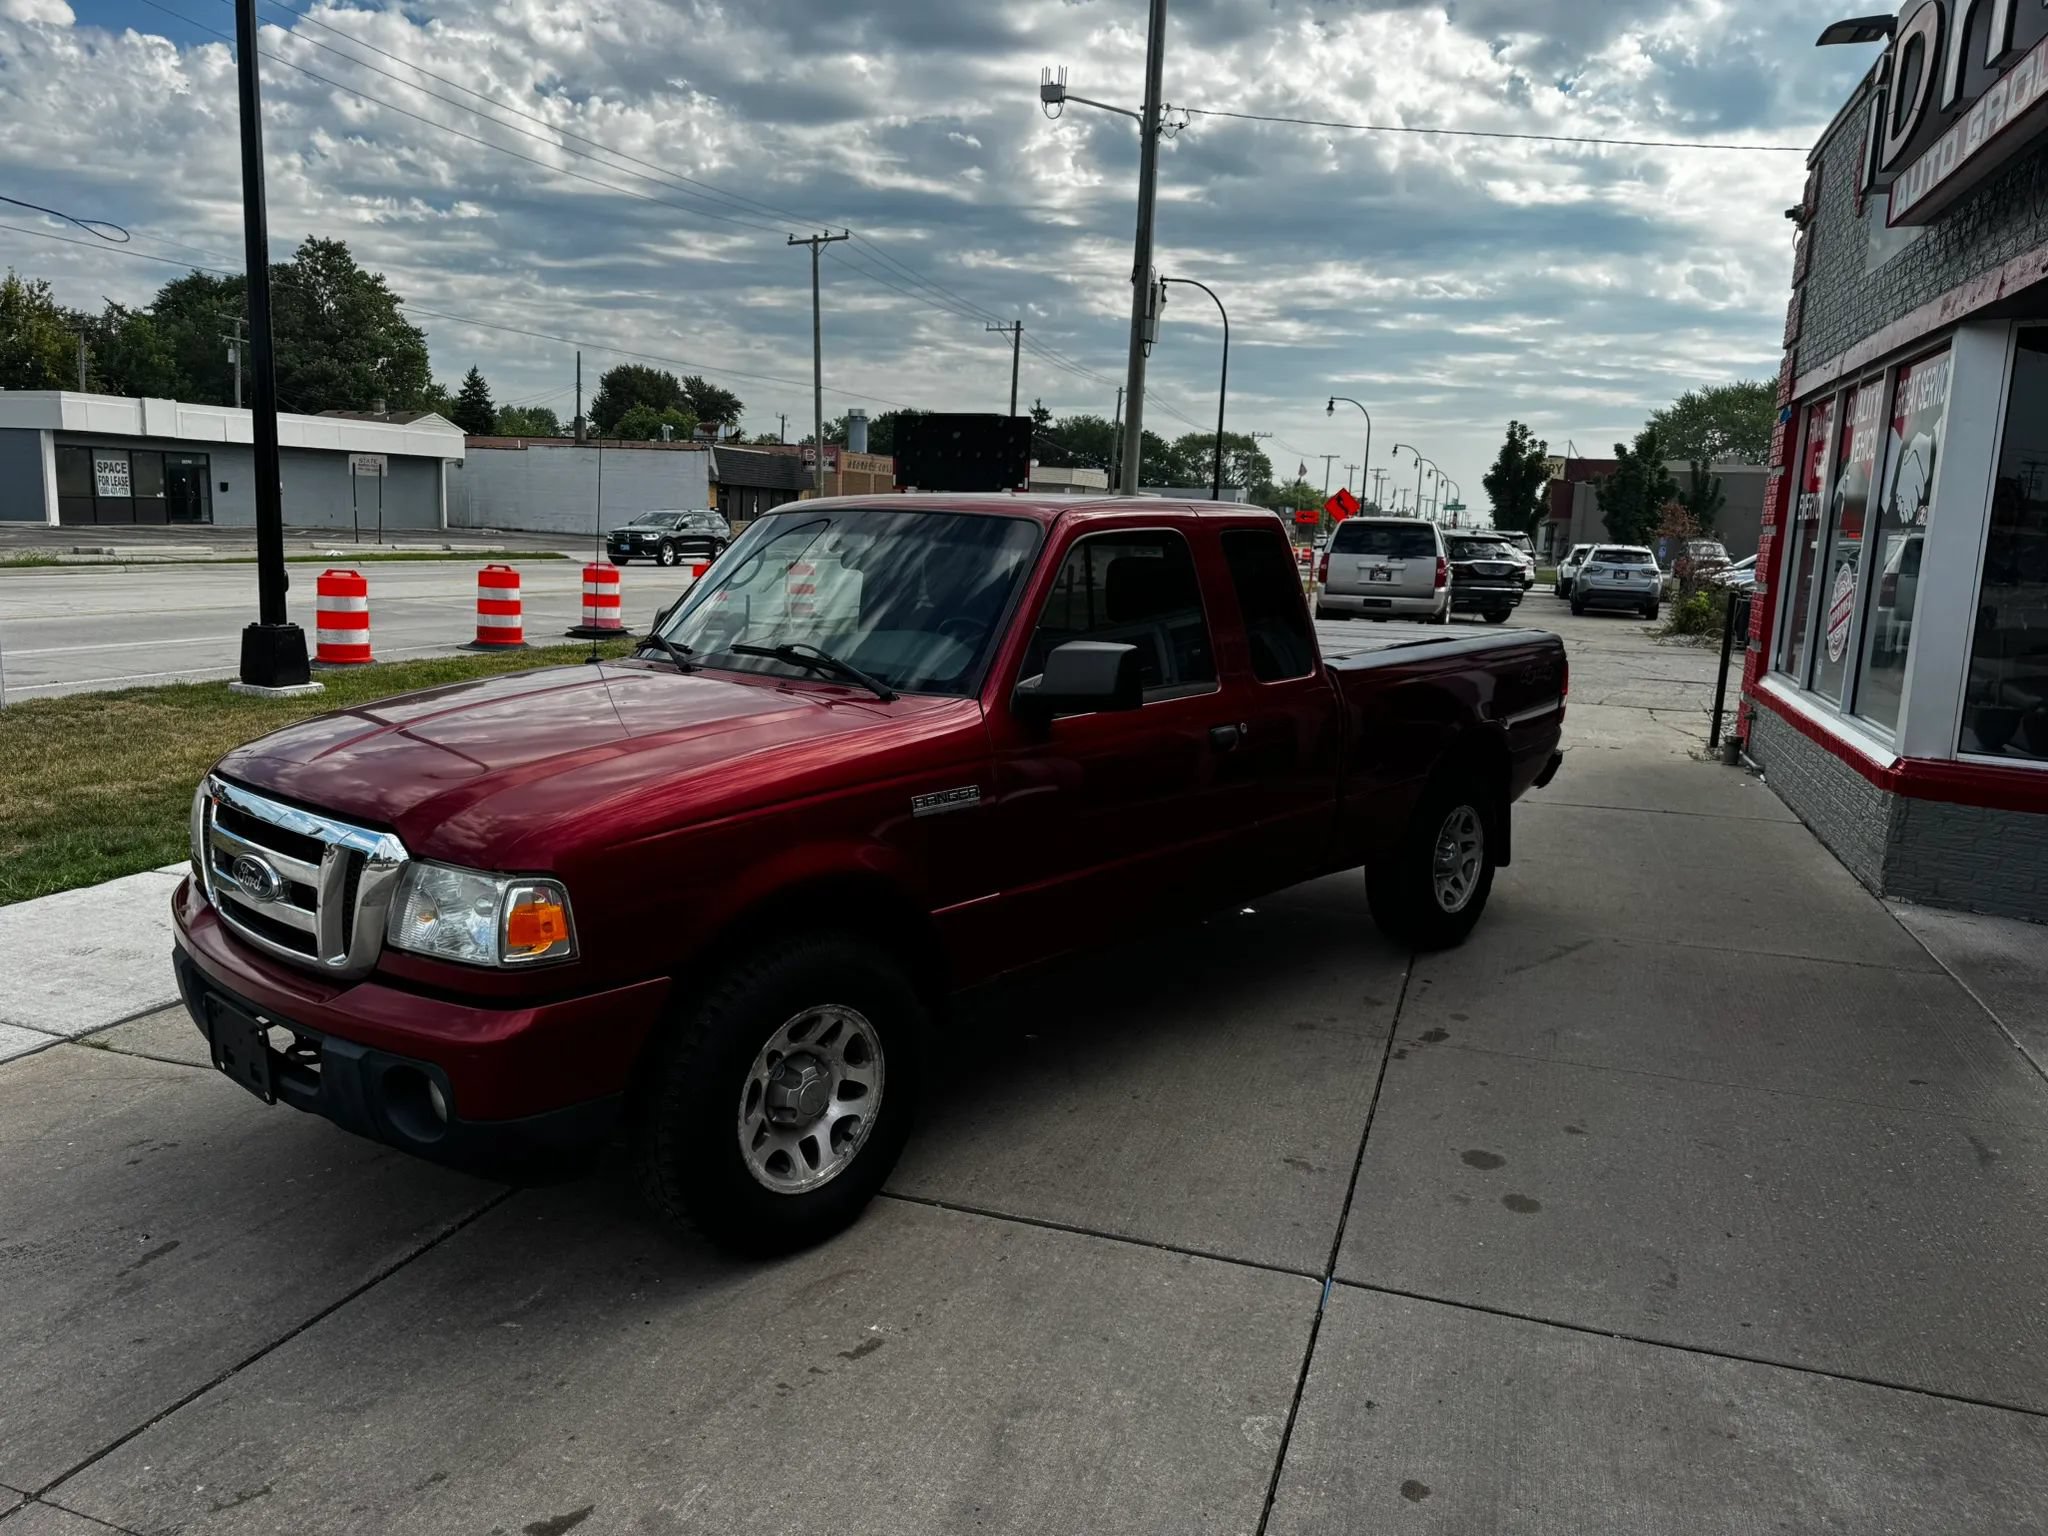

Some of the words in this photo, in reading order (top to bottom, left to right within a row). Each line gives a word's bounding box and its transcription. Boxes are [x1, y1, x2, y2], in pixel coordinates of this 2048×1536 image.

[1892, 126, 1960, 221] AUTO
[1895, 372, 1922, 418] GREAT
[1918, 360, 1949, 412] SERVIC
[1846, 382, 1884, 427] QUALITY
[97, 461, 128, 474] SPACE
[98, 475, 110, 487] FOR
[110, 475, 129, 487] LEASE
[1797, 491, 1824, 520] EVERYO
[914, 787, 979, 810] RANGER
[238, 861, 263, 891] Ford
